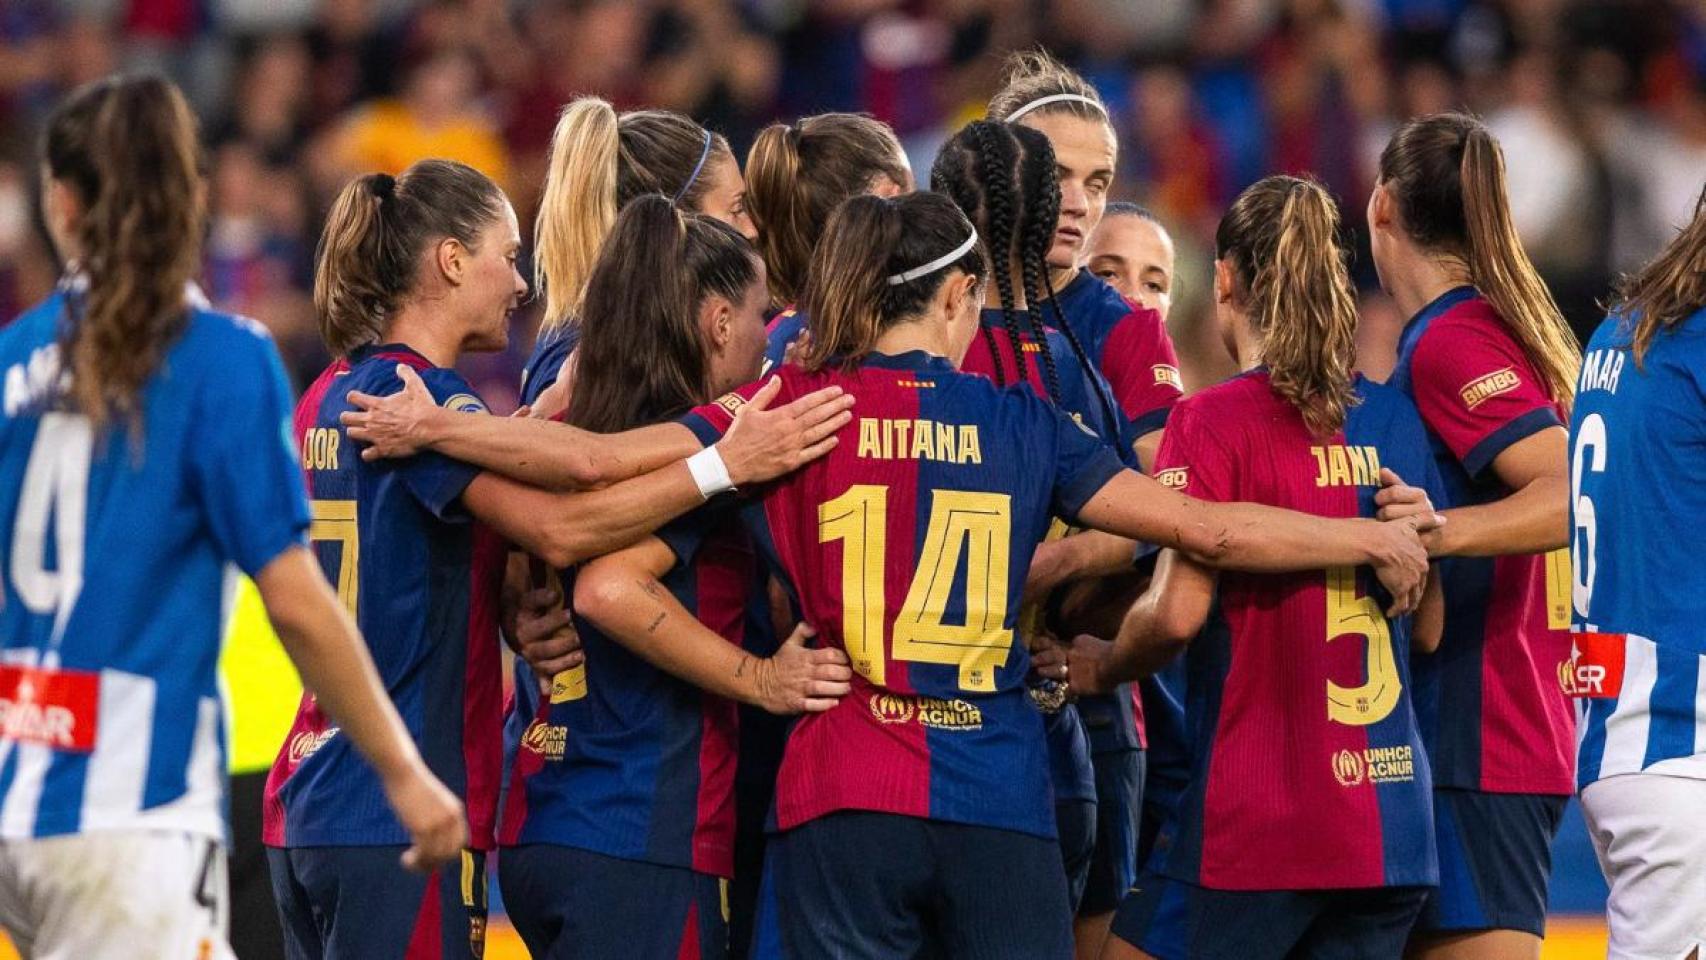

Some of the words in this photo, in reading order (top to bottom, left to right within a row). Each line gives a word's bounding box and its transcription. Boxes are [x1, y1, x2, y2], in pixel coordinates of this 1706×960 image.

[1462, 370, 1518, 406] BIMBO
[1580, 349, 1625, 395] MAR
[303, 427, 340, 470] JOR
[858, 417, 982, 464] AITANA
[1310, 445, 1382, 487] JANA
[9, 411, 93, 648] 4
[1572, 413, 1606, 618] 6
[309, 500, 359, 625] 7
[818, 484, 1013, 692] 14
[1326, 566, 1402, 726] 5
[917, 710, 982, 725] ACNUR
[1363, 745, 1412, 762] UNHCR
[1367, 760, 1414, 777] ACNUR
[193, 837, 218, 928] 4
